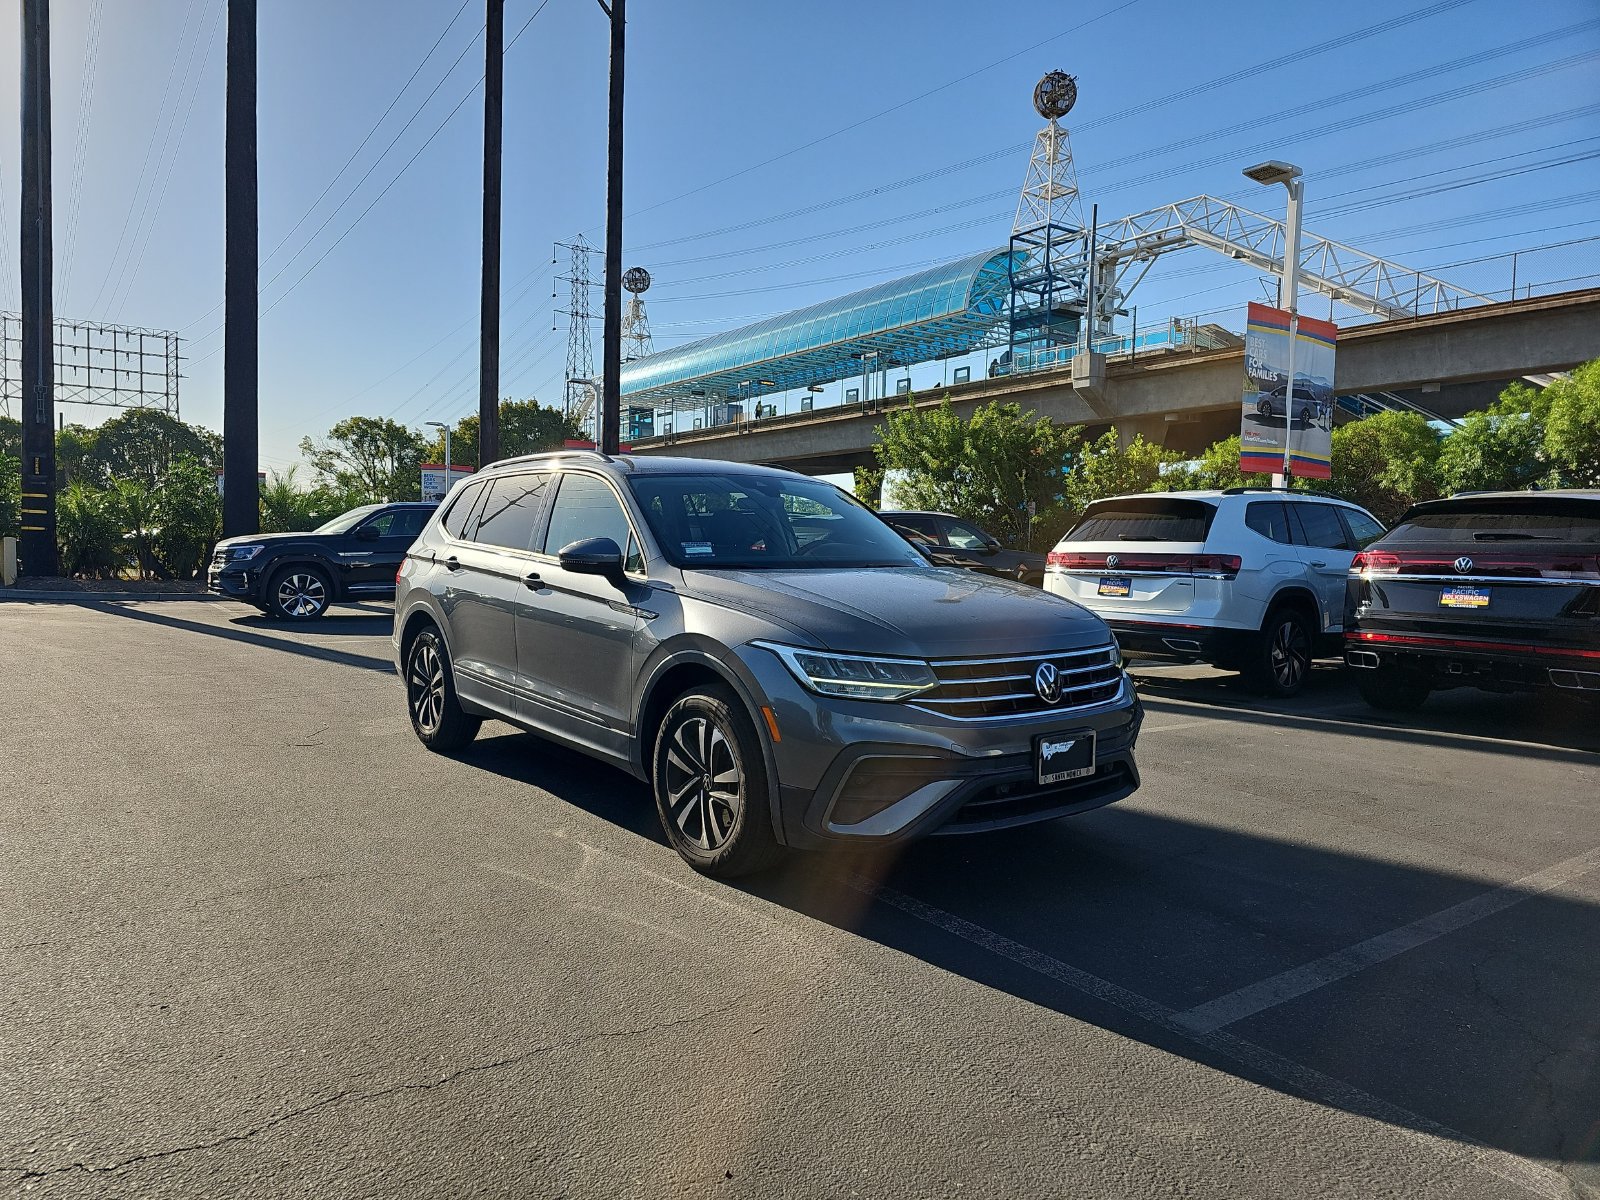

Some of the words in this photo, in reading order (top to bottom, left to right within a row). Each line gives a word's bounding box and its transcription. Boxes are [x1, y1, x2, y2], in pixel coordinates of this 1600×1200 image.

[1249, 336, 1266, 349] BEST
[1249, 347, 1267, 359] CARS
[1248, 357, 1263, 369] FOR
[1248, 367, 1278, 382] FAMILIES
[1442, 594, 1489, 602] VOLKSWAGEN
